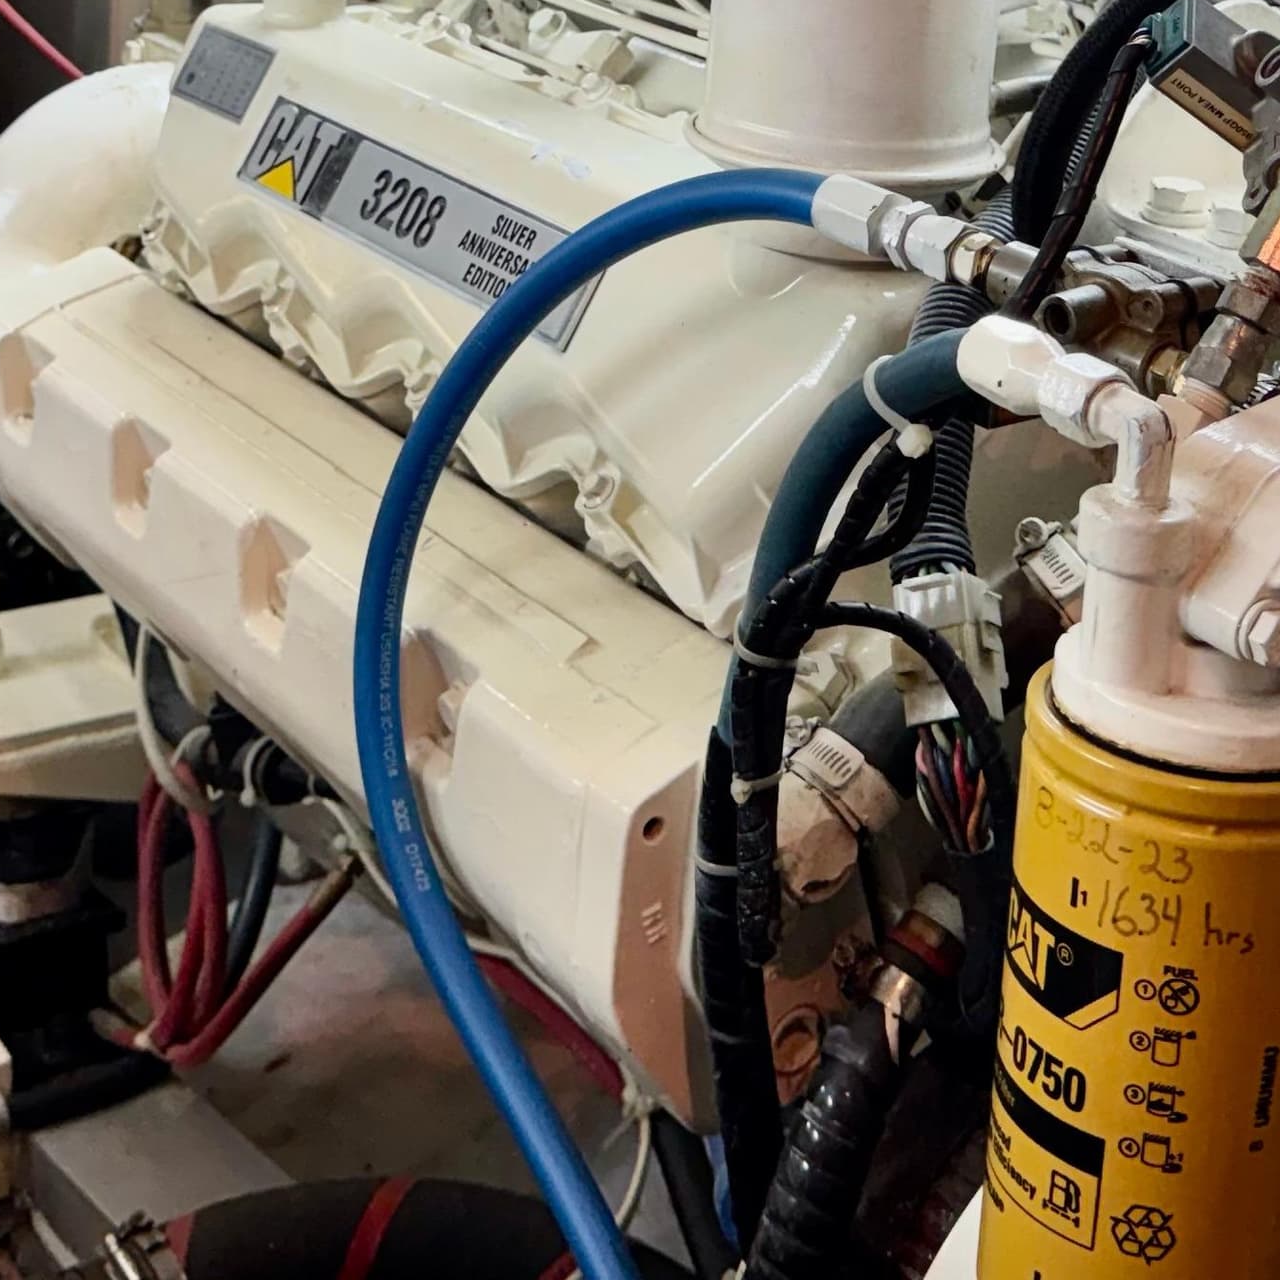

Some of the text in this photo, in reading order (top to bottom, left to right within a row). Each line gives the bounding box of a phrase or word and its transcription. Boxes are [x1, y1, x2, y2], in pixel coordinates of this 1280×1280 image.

[248, 104, 347, 207] CAT
[360, 169, 448, 249] 3208
[491, 214, 538, 251] SILVER
[458, 230, 535, 276] ANNIVERSA
[463, 263, 513, 299] EDITIO
[384, 557, 406, 629] RESISTANT
[1008, 886, 1056, 992] CAT
[1097, 879, 1255, 955] 1634 hrs
[1163, 965, 1199, 981] FUEL
